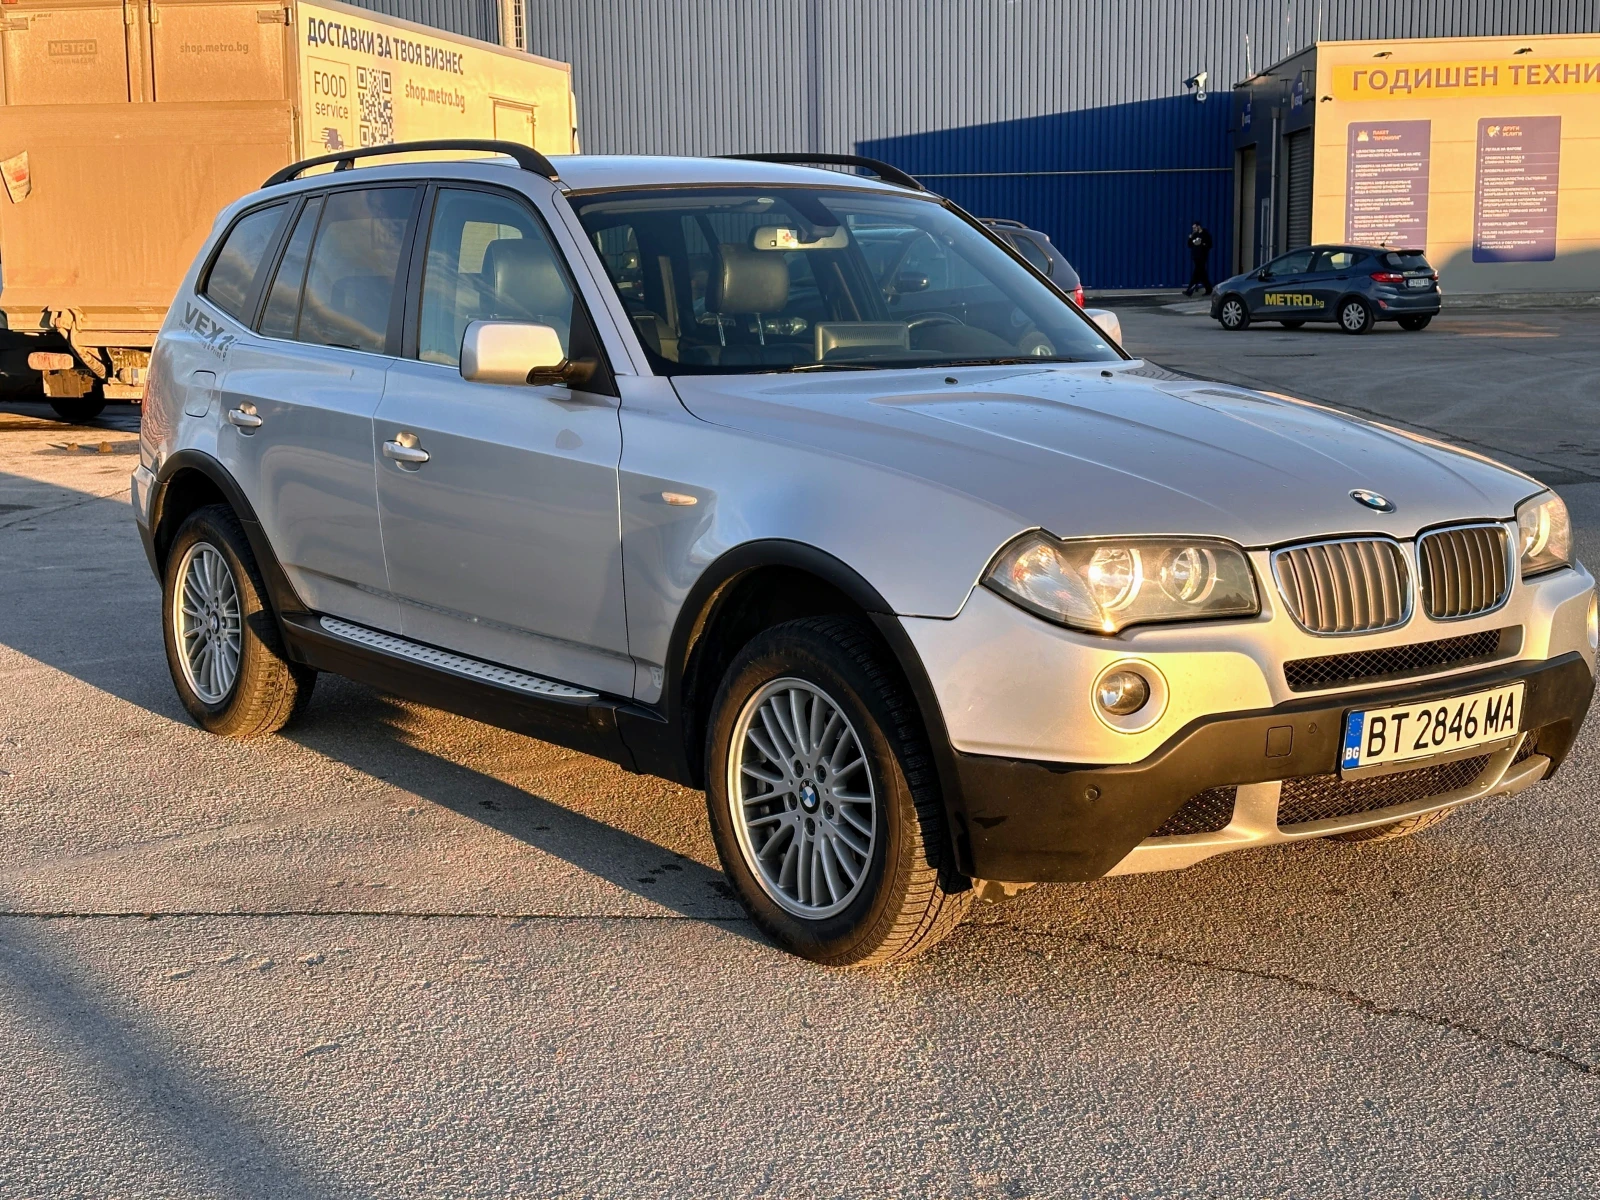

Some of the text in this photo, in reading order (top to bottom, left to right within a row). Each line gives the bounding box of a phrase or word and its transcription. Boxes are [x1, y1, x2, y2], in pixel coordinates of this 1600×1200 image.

[49, 41, 97, 54] METRO
[180, 41, 249, 55] shop.metro.bg
[307, 17, 464, 75] ДОСТАВКИ ЗА ТВОЯ БИЗНЕС
[313, 70, 347, 99] FOOD
[1353, 63, 1600, 95] ГОДИШЕН ТЕХНИ
[405, 79, 466, 114] shop.metro.bg
[315, 100, 349, 120] service
[1264, 293, 1325, 309] METRO.bg
[1367, 692, 1514, 758] BT 2846 MA
[1345, 747, 1360, 760] BG
